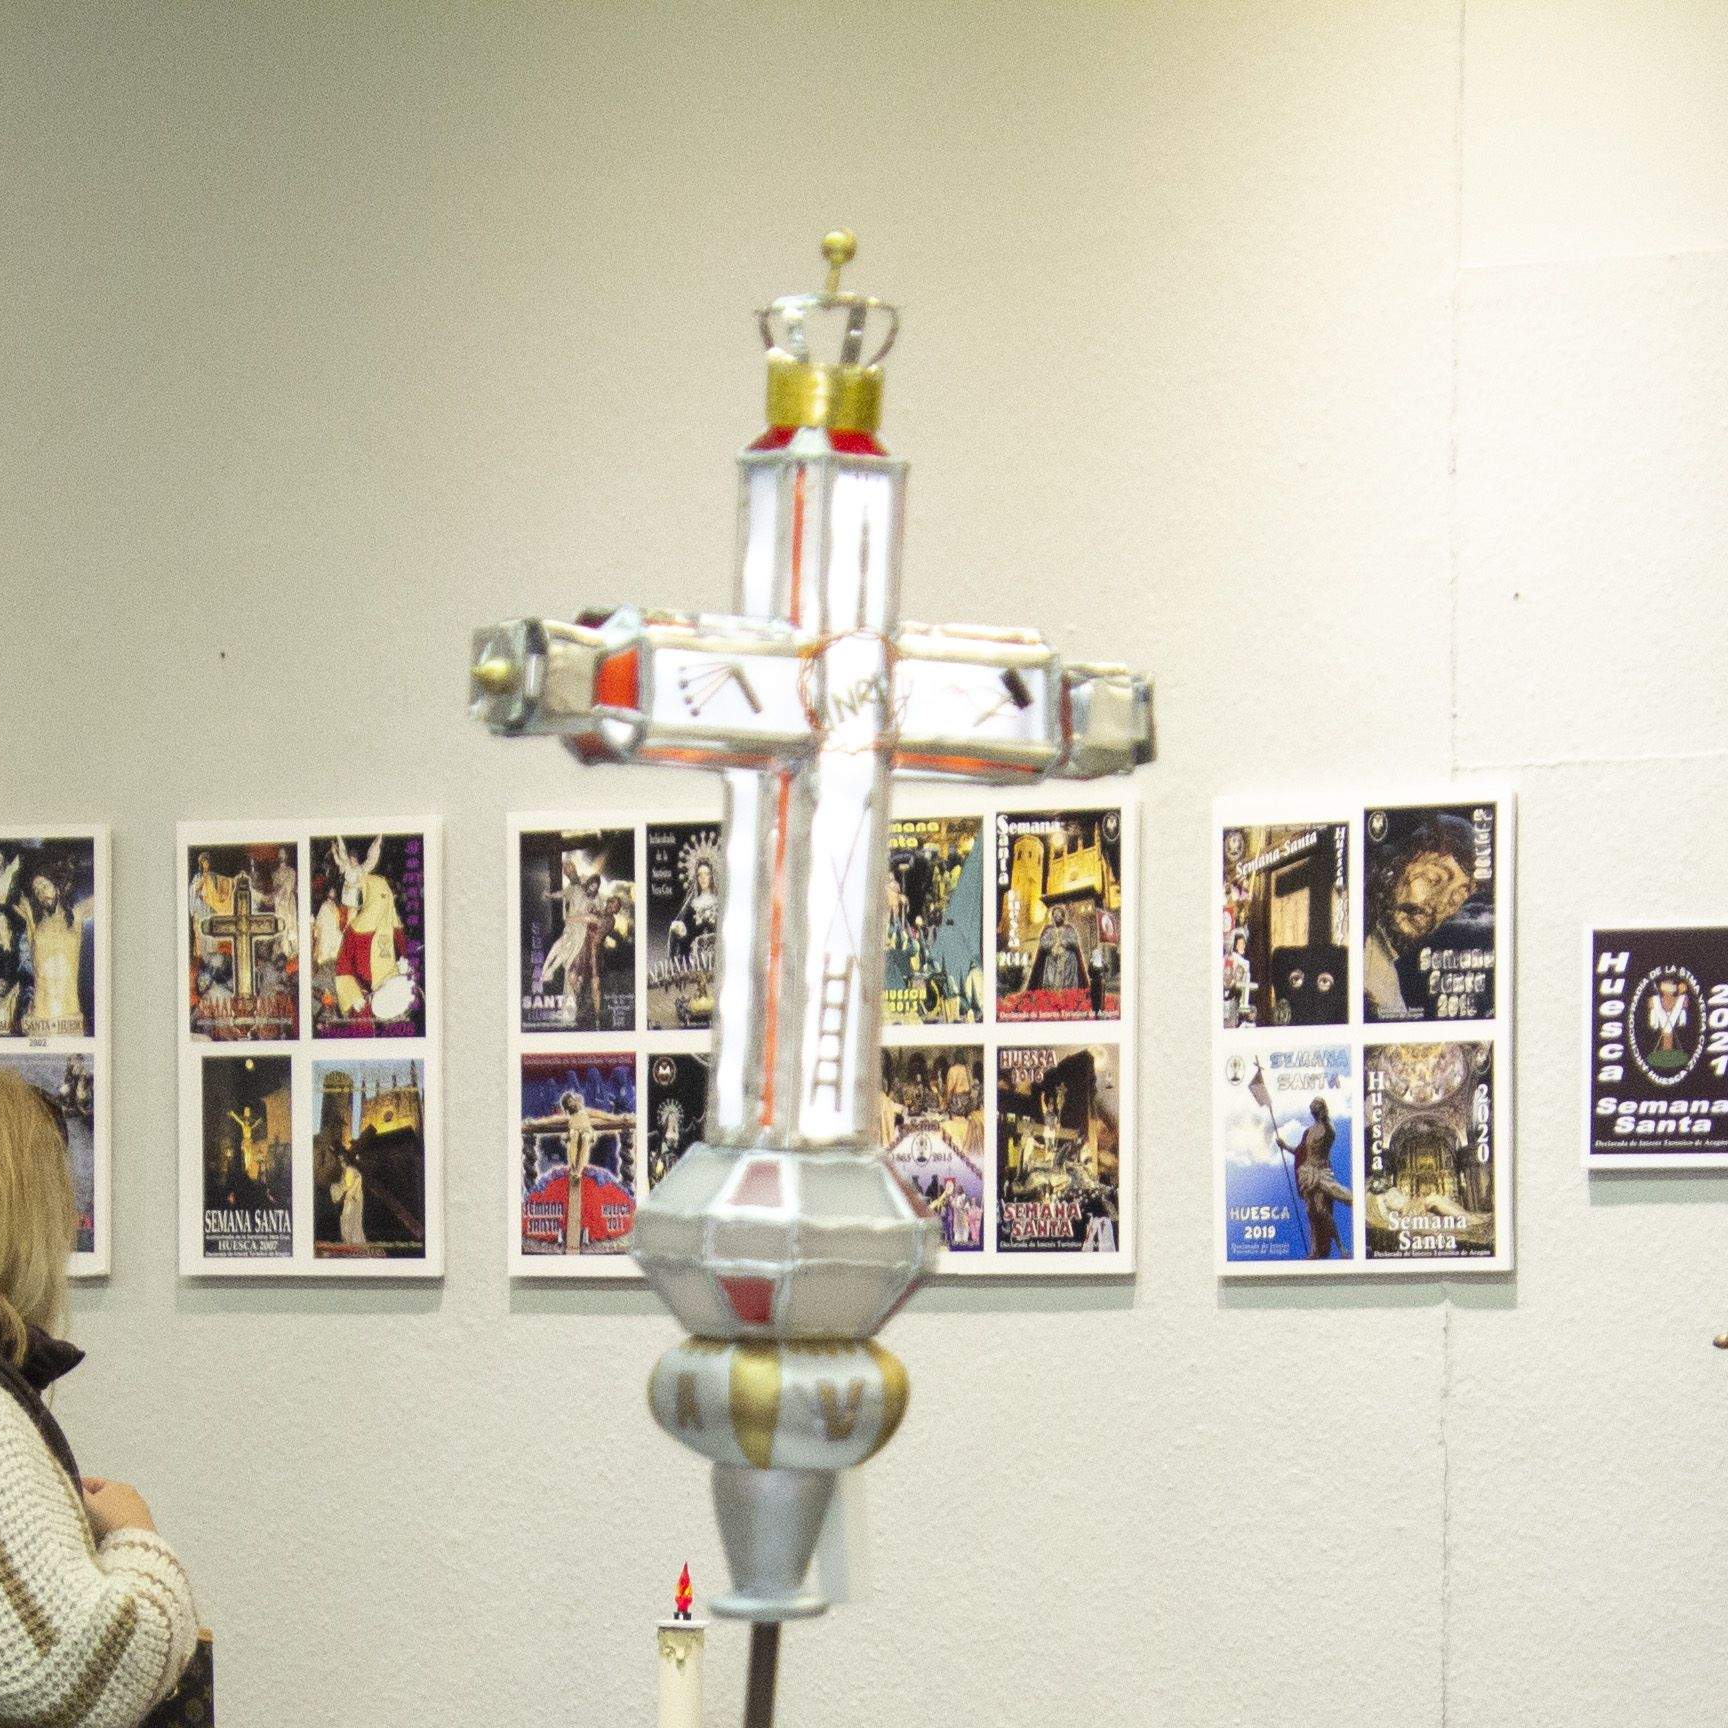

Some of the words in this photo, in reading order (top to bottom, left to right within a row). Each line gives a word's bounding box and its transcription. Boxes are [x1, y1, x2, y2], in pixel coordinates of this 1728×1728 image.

[997, 815, 1062, 834] Semana
[1236, 849, 1280, 880] Semana
[1282, 831, 1318, 857] Santa
[1665, 964, 1677, 974] LA
[1597, 952, 1629, 1081] Huesca
[999, 1050, 1057, 1068] HUESCA
[1270, 1051, 1350, 1068] SEMANA
[1277, 1074, 1342, 1090] SANTA
[1368, 1071, 1386, 1170] Huesca
[1476, 1084, 1490, 1163] 2020
[1615, 1116, 1712, 1134] Santa
[1004, 1200, 1082, 1220] SEMANA
[1230, 1206, 1290, 1220] HUESCA
[205, 1210, 251, 1233] SEMANA
[255, 1209, 291, 1232] SANTA
[1012, 1220, 1074, 1238] SANTA
[1387, 1211, 1468, 1231] Semana
[1244, 1225, 1275, 1239] 2019
[1399, 1230, 1457, 1250] Santa
[218, 1241, 257, 1250] HUESCA
